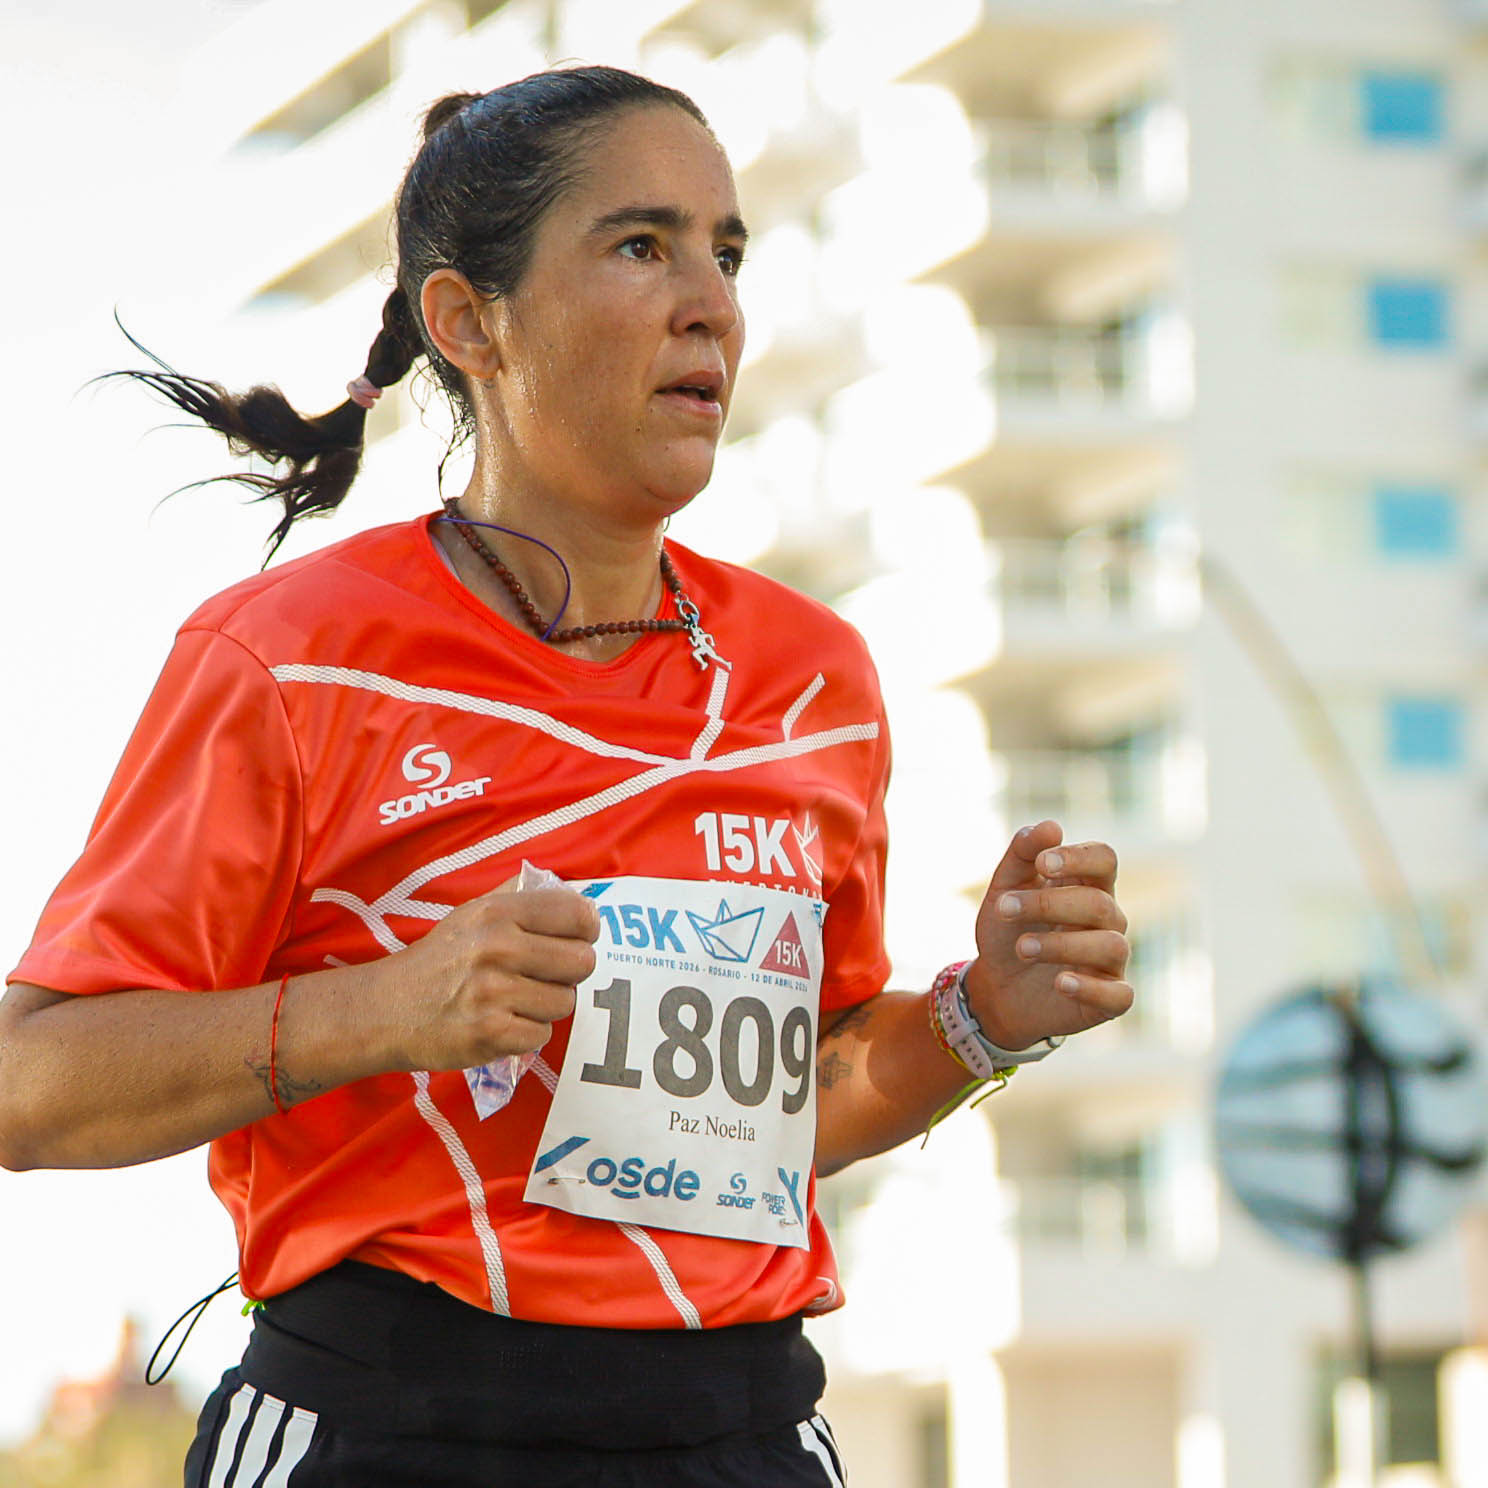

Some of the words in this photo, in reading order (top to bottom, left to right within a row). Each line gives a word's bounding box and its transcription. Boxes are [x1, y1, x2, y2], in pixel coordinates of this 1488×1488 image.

[695, 812, 796, 877] 15K
[598, 904, 687, 953] 15K
[607, 952, 643, 965] PUERTO
[646, 957, 676, 969] NORTE
[679, 961, 700, 972] 2026
[708, 965, 741, 980] ROSARIO
[752, 972, 760, 983] 12
[763, 974, 773, 985] DE
[775, 940, 802, 969] 15K
[580, 977, 811, 1115] 1809
[669, 1110, 699, 1134] Paz
[705, 1115, 756, 1141] Noelia
[587, 1157, 700, 1201] osde
